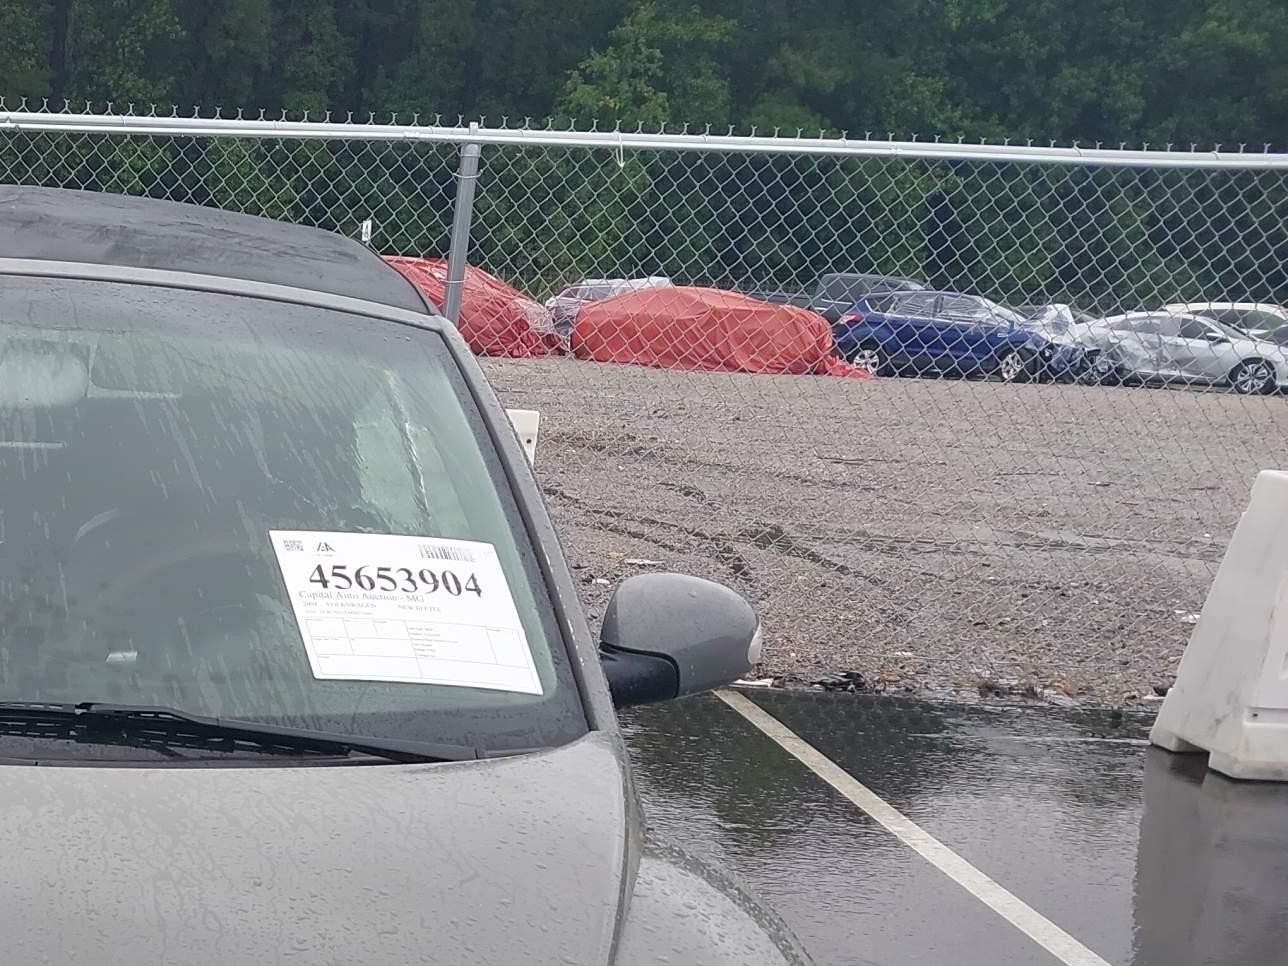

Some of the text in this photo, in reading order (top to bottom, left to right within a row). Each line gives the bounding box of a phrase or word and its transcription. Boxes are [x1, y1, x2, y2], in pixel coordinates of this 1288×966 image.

[309, 563, 483, 599] 45653904
[298, 590, 333, 600] Capital
[337, 591, 359, 600] Auto
[362, 592, 398, 601] Auction
